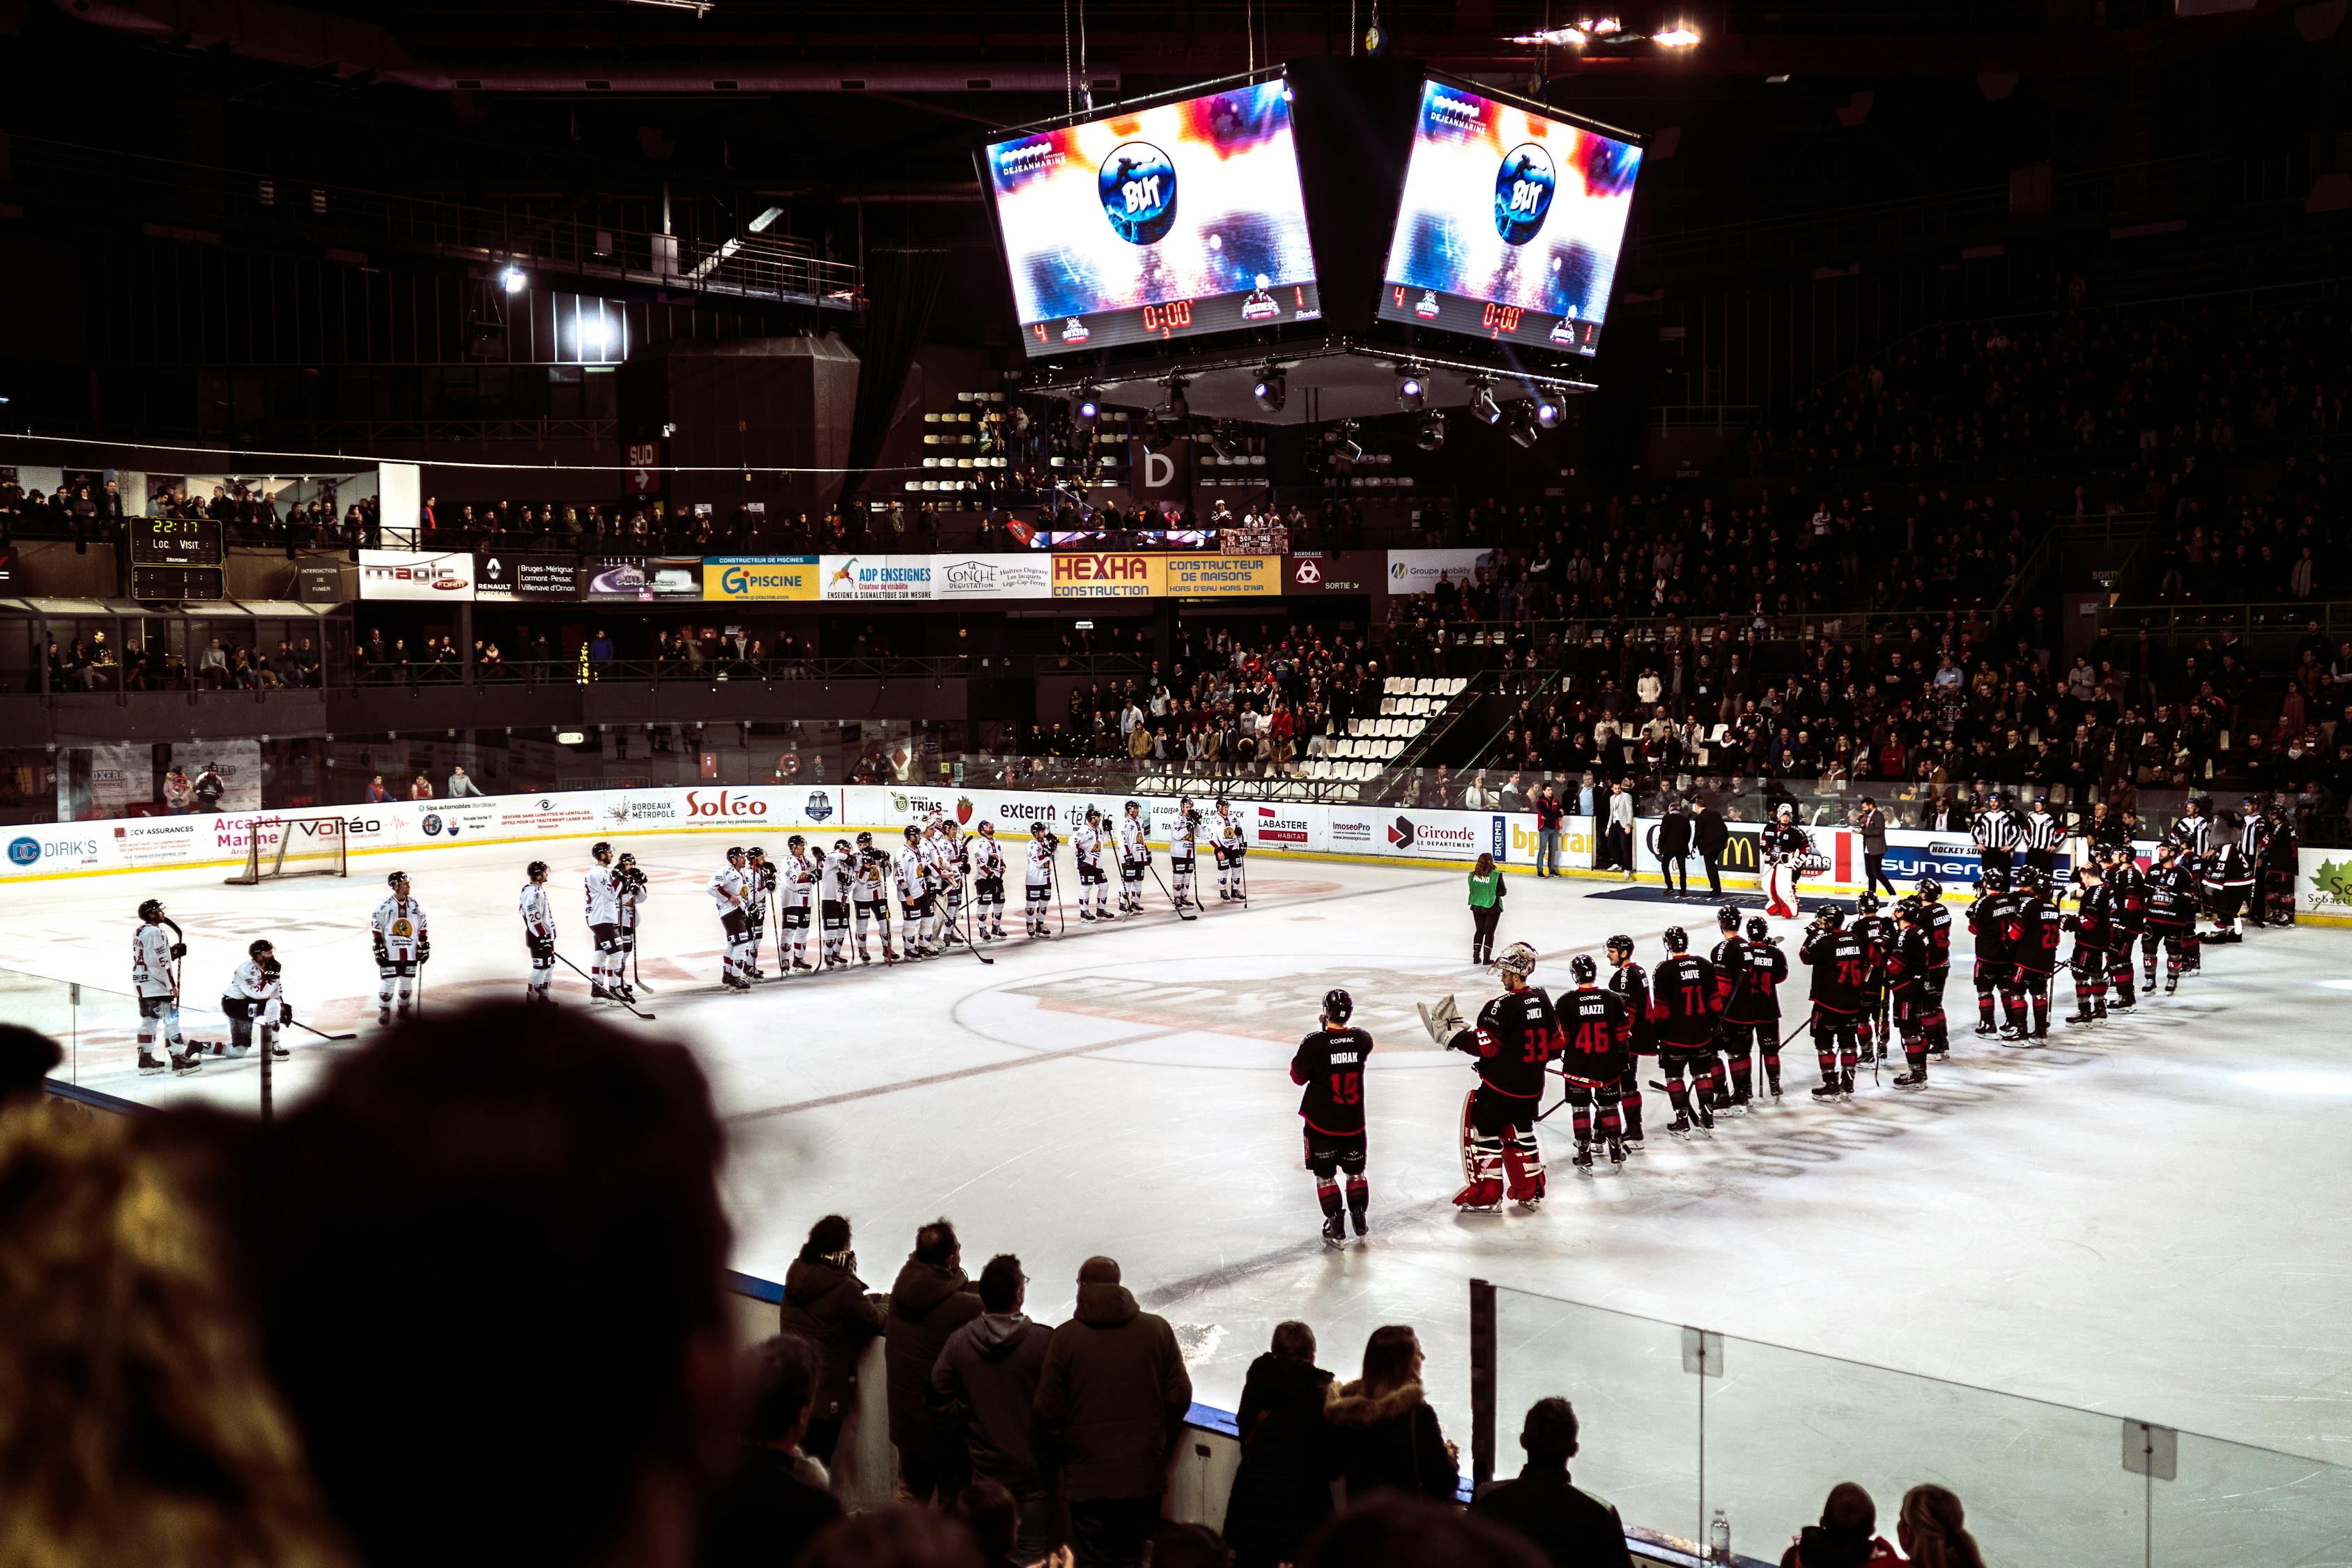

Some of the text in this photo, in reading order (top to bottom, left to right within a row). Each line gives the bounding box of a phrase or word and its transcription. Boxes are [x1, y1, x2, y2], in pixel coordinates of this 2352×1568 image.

[1431, 112, 1486, 134] DEJEANMARINE
[1003, 156, 1066, 176] DEJEANMARINE
[1121, 175, 1161, 215] BUT
[1510, 180, 1542, 215] BUT
[1034, 286, 1304, 343] 4 0:00 1
[1394, 286, 1404, 307] 4
[1483, 302, 1519, 332] 0:00
[1585, 324, 1592, 342] 1
[1162, 326, 1171, 339] 3
[1491, 327, 1498, 339] 3
[630, 445, 652, 466] SUD
[1144, 453, 1175, 487] D
[153, 521, 197, 532] 22:17
[546, 565, 574, 574] Mérignac
[1054, 555, 1147, 580] HEXHA
[1169, 560, 1263, 570] CONSTRUCTEUR
[365, 562, 454, 585] magic
[859, 568, 931, 581] ADP ENSEIGNES
[947, 567, 997, 583] CONCHE
[1181, 571, 1252, 581] DE MAISONS
[750, 576, 801, 587] PISCINE
[1054, 585, 1148, 597] CONSTRUCTION
[686, 790, 767, 817] Soléo
[910, 801, 941, 812] TRIAS
[633, 810, 675, 819] MÉTROPOLE
[146, 826, 194, 835] ASSURANCES
[300, 817, 381, 836] Voltéo
[1259, 820, 1307, 829] LABASTERE
[1333, 822, 1370, 831] ImoseoPro
[1417, 825, 1475, 840] Gironde
[45, 840, 97, 857] DIRIK'S
[1932, 846, 1965, 855] HOCKEY
[529, 912, 541, 923] 20
[1836, 960, 1861, 986] 76
[1681, 985, 1706, 1015] 71
[1579, 1004, 1604, 1015] BAAZZI
[1477, 1031, 1491, 1045] 33
[1523, 1027, 1548, 1063] 33
[1575, 1022, 1609, 1054] 46
[1330, 1052, 1358, 1064] HORAK
[1329, 1072, 1360, 1105] 19
[1464, 1146, 1477, 1183] CCM
